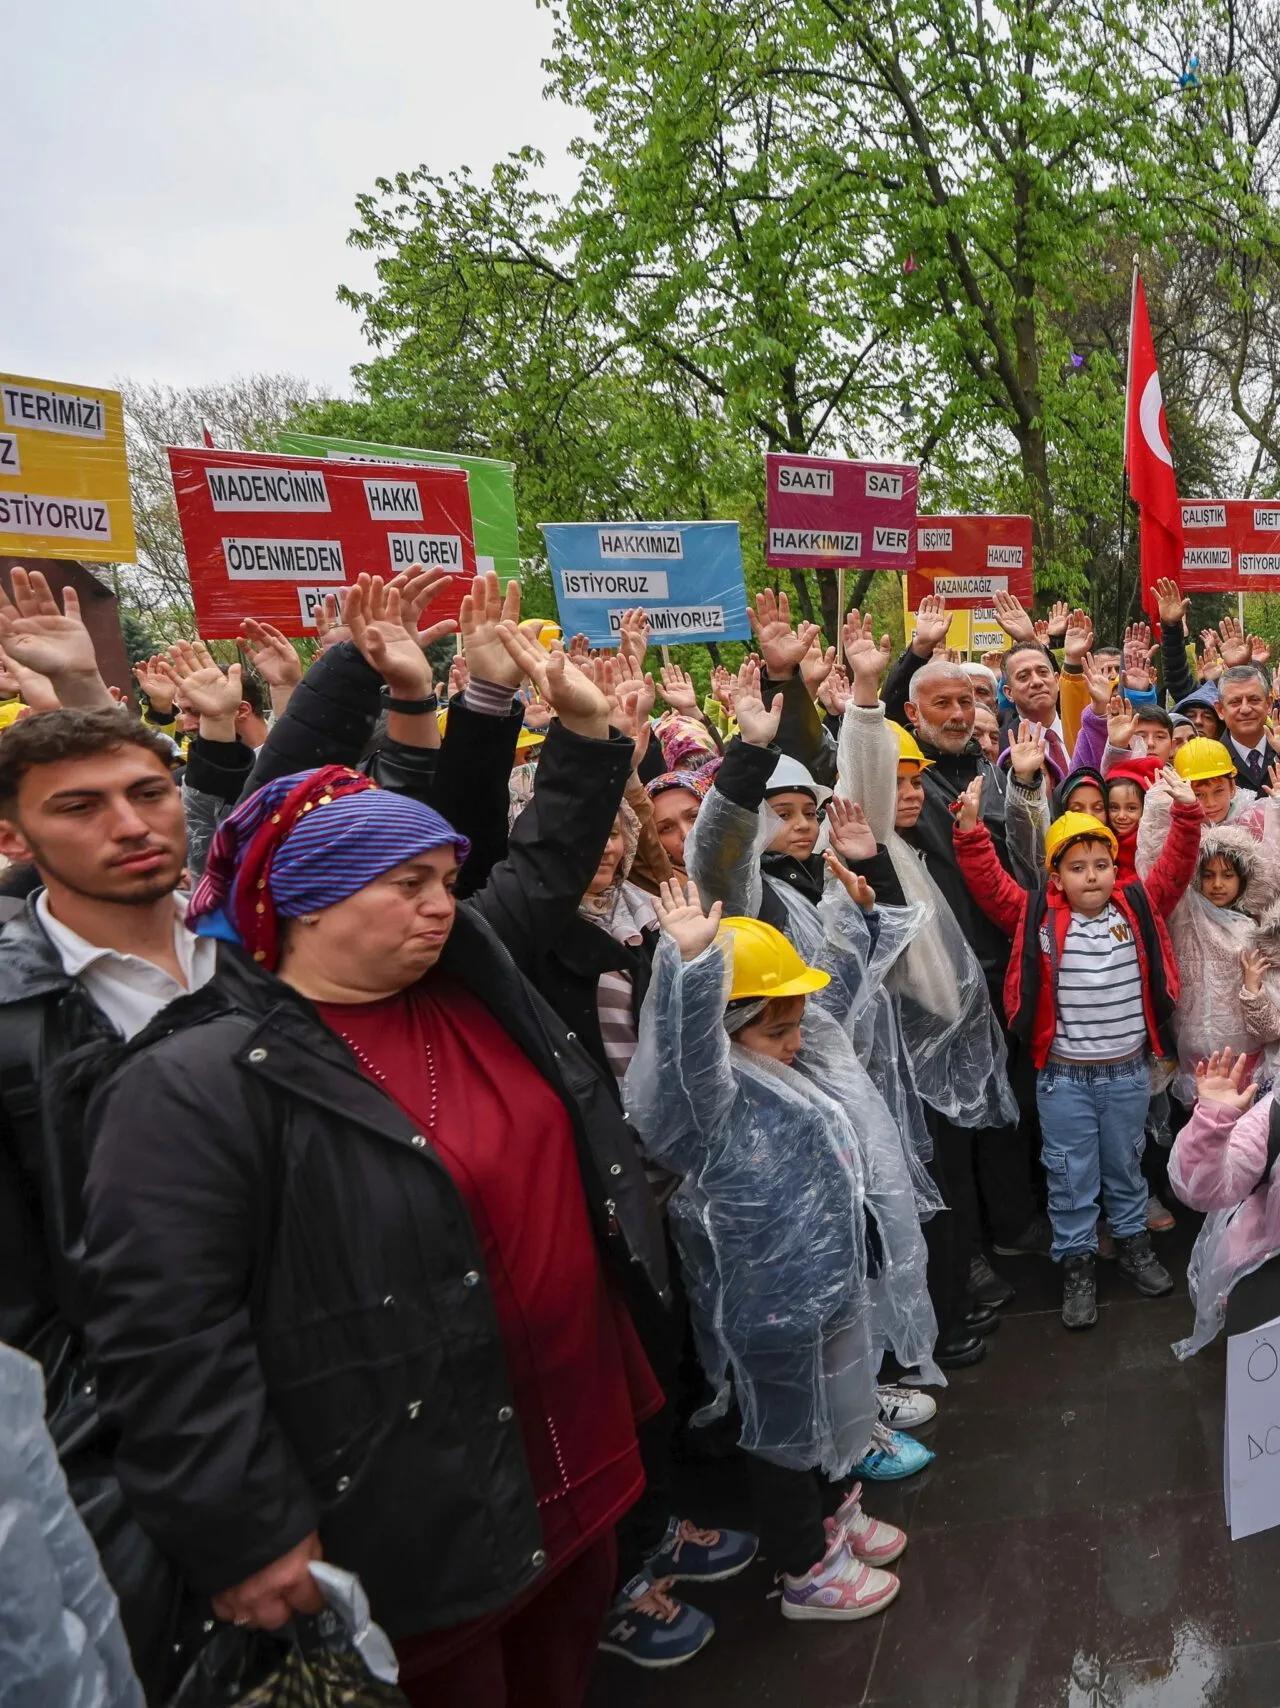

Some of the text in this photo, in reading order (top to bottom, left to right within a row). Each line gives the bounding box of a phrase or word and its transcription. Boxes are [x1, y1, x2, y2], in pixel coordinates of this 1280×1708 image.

[5, 390, 102, 431] TERİMİZİ
[208, 470, 420, 512] MADENCİNİN HAKKI
[779, 470, 900, 494] SAATİ SAT
[0, 494, 108, 532] STİYORUZ
[1182, 508, 1224, 527] ÇALIŞTIK
[601, 535, 681, 554] HAKKIMIZI
[773, 530, 907, 551] HAKKIMIZI VER
[923, 529, 951, 549] İŞÇİYİZ
[227, 538, 459, 572] ÖDENMEDEN BU GREV
[988, 548, 1022, 564] HAKLIYIZ
[1183, 551, 1230, 564] HAKKIMIZI
[564, 572, 649, 594] İSTİYORUZ
[935, 577, 992, 593] KAZANACAĞIZ
